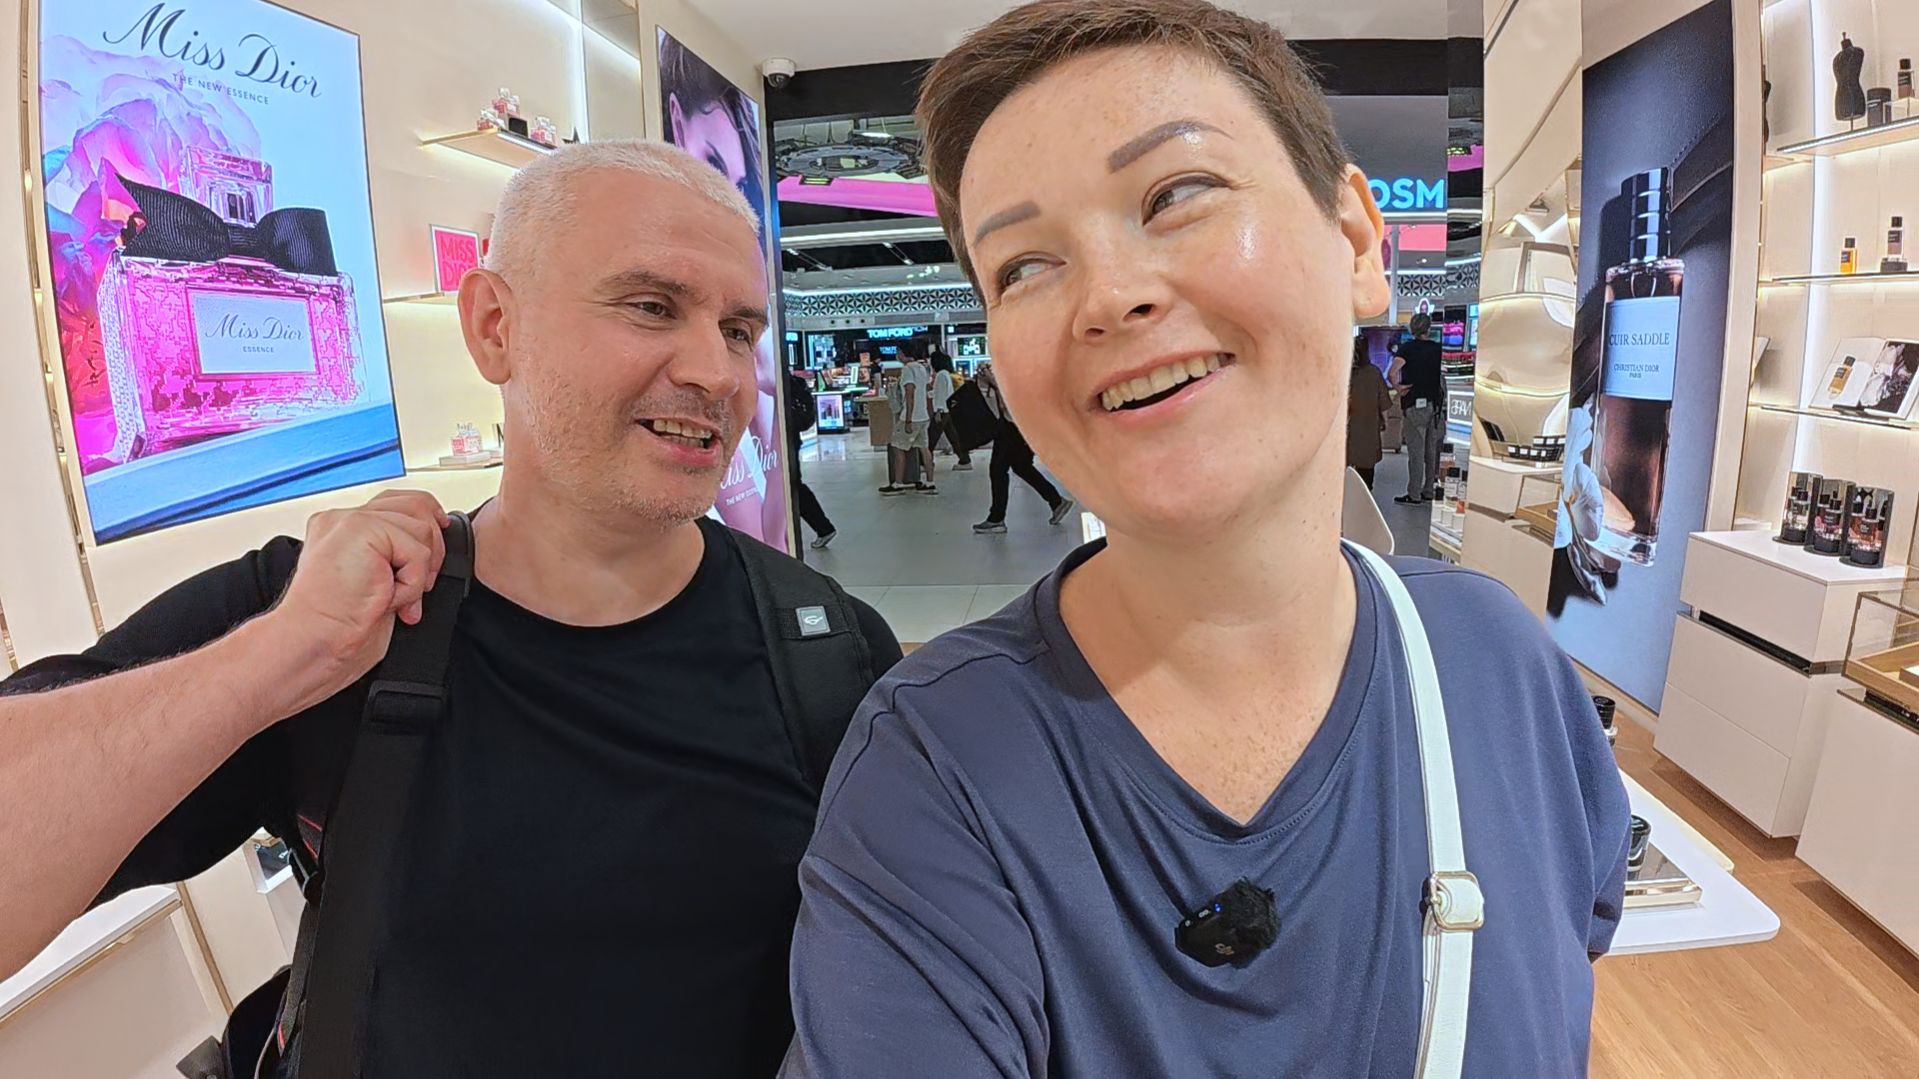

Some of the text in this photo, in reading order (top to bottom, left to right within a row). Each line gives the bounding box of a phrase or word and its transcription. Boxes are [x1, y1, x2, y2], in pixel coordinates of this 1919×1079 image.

[103, 2, 322, 98] Miss Dior
[172, 73, 270, 105] THE NEW ESSENCE
[441, 235, 475, 264] MISS
[205, 313, 304, 341] Miss Dior
[867, 327, 913, 338] TOM FORD
[1609, 333, 1670, 346] CUIR SADDLE
[720, 456, 745, 489] iss
